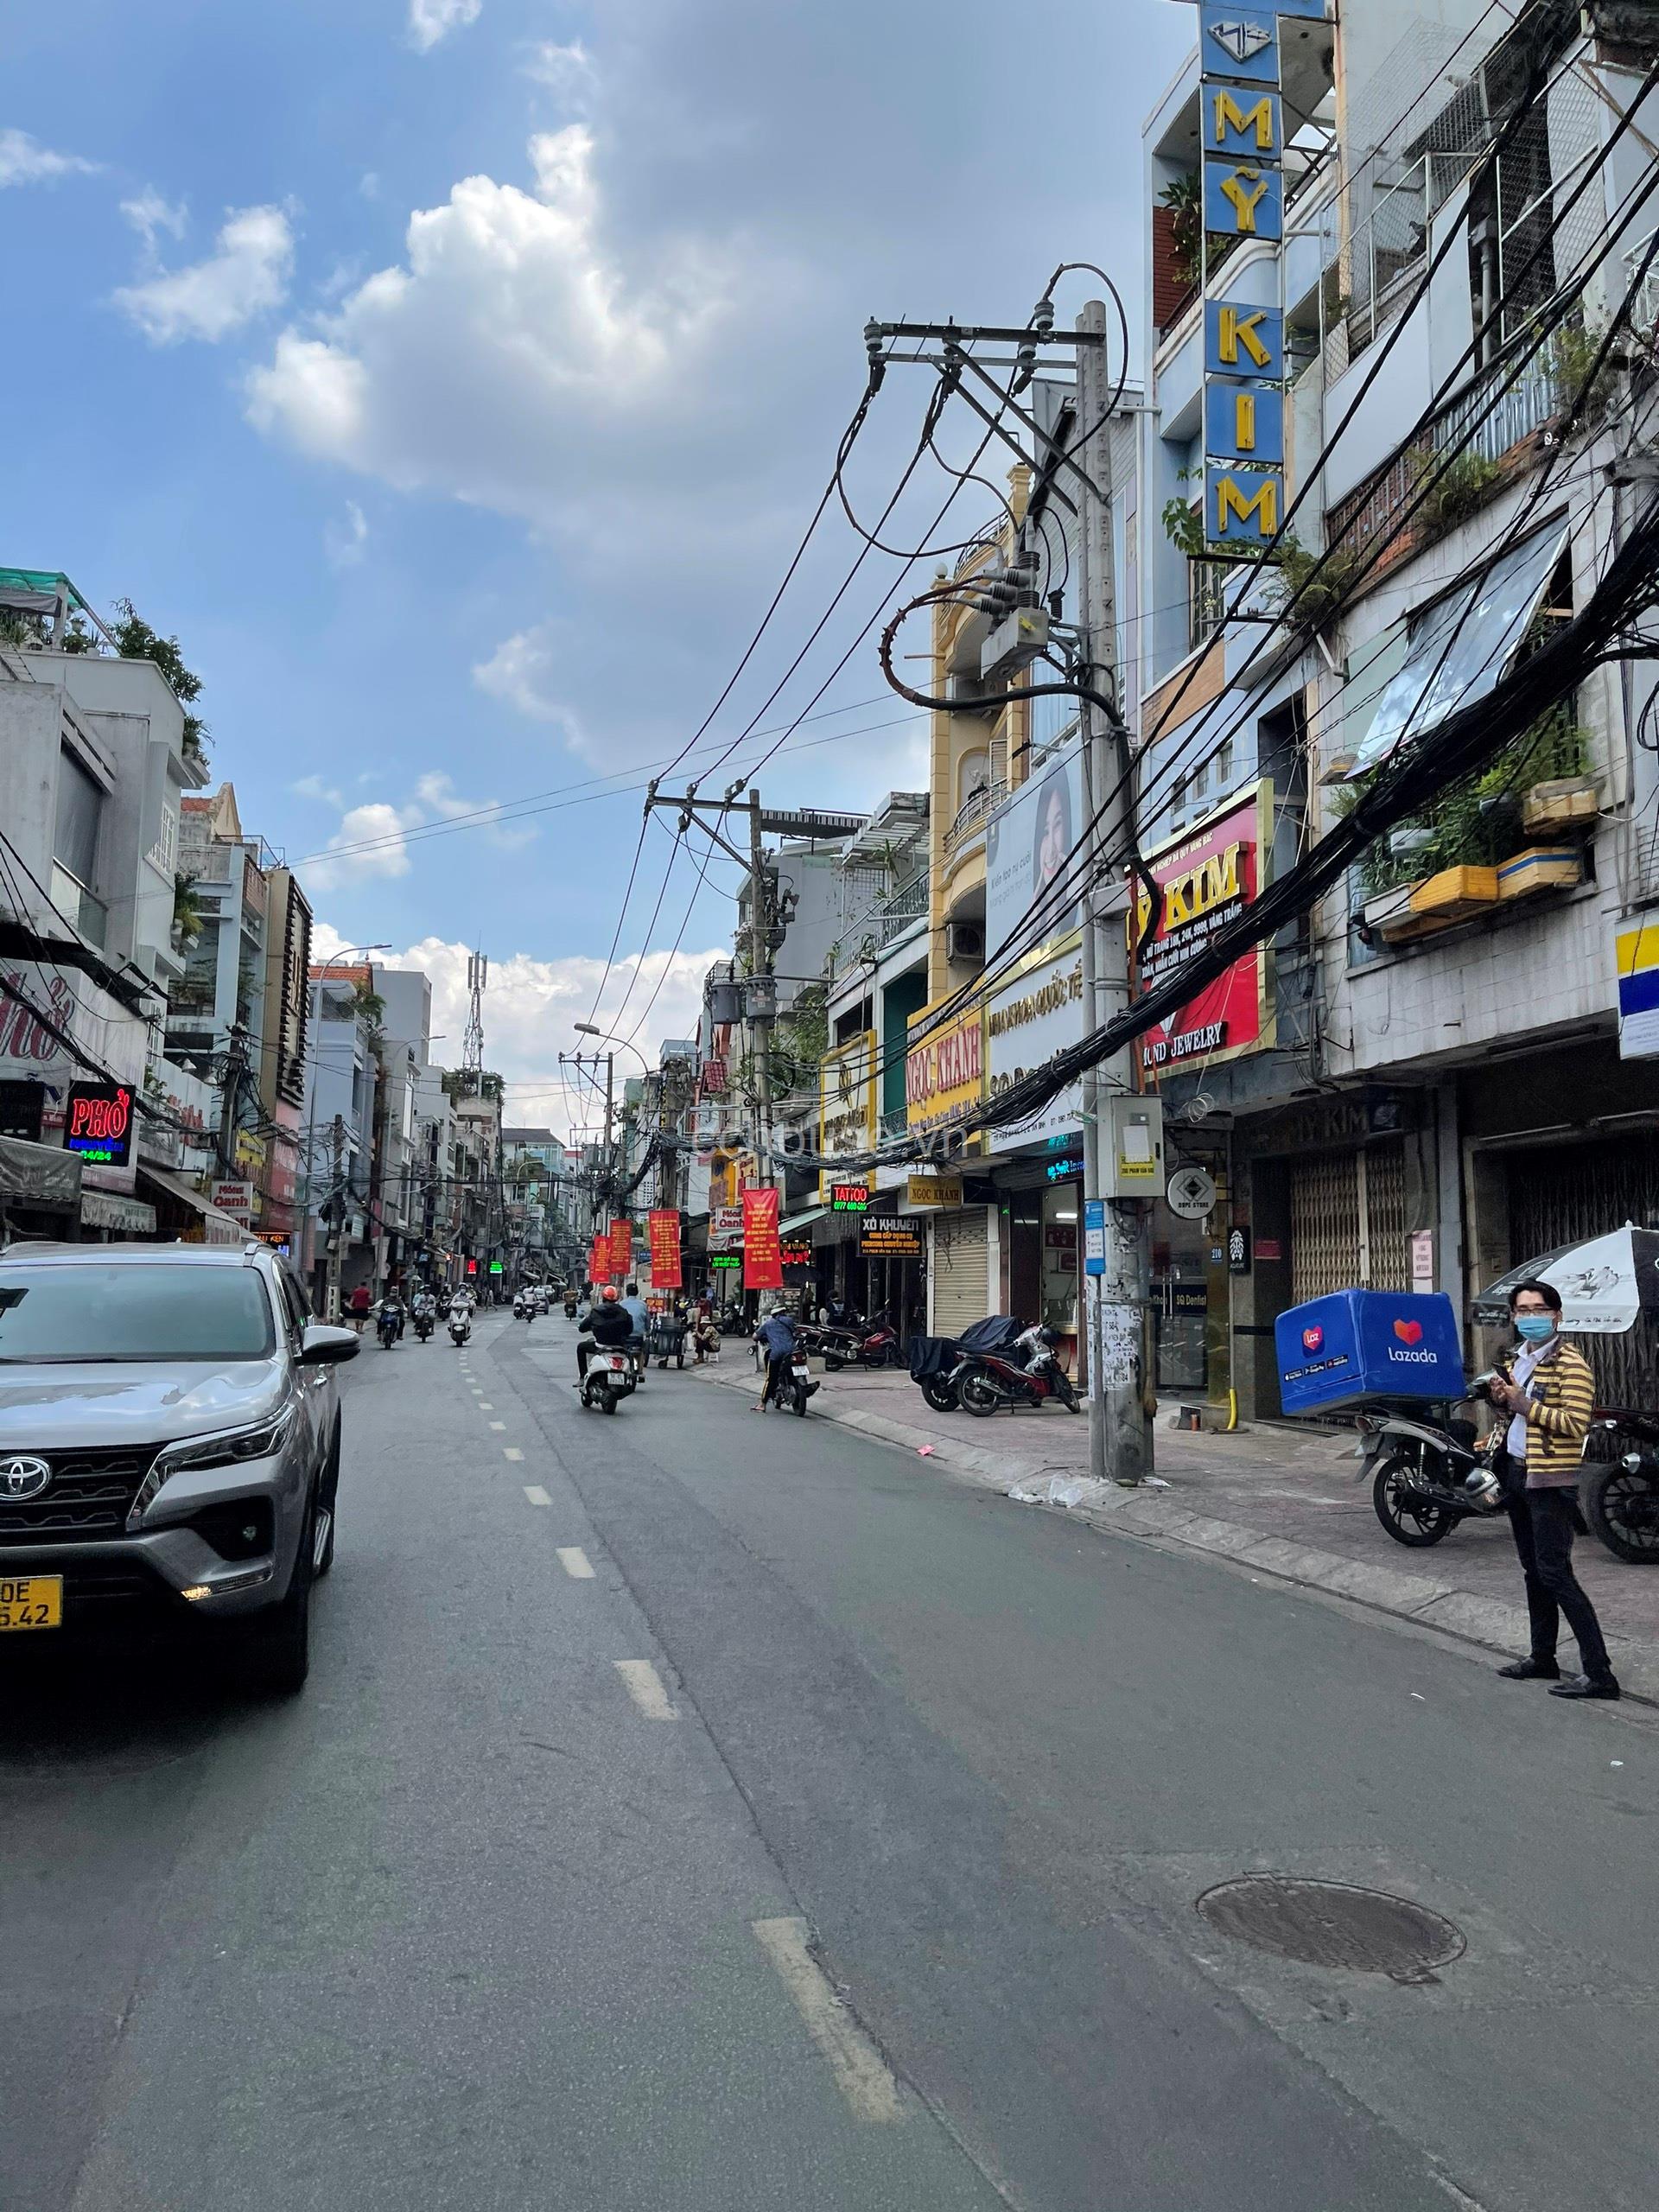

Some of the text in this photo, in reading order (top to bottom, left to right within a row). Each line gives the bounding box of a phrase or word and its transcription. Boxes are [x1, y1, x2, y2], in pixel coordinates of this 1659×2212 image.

[1217, 307, 1278, 536] KIM
[1163, 841, 1241, 933] KIM
[1171, 1021, 1222, 1058] JEWELRY
[70, 1088, 130, 1139] PHỞ
[834, 1187, 868, 1202] TATTOO
[1388, 1346, 1438, 1363] Lazada
[0, 1581, 30, 1603] 0E
[0, 1604, 49, 1626] 5.42
